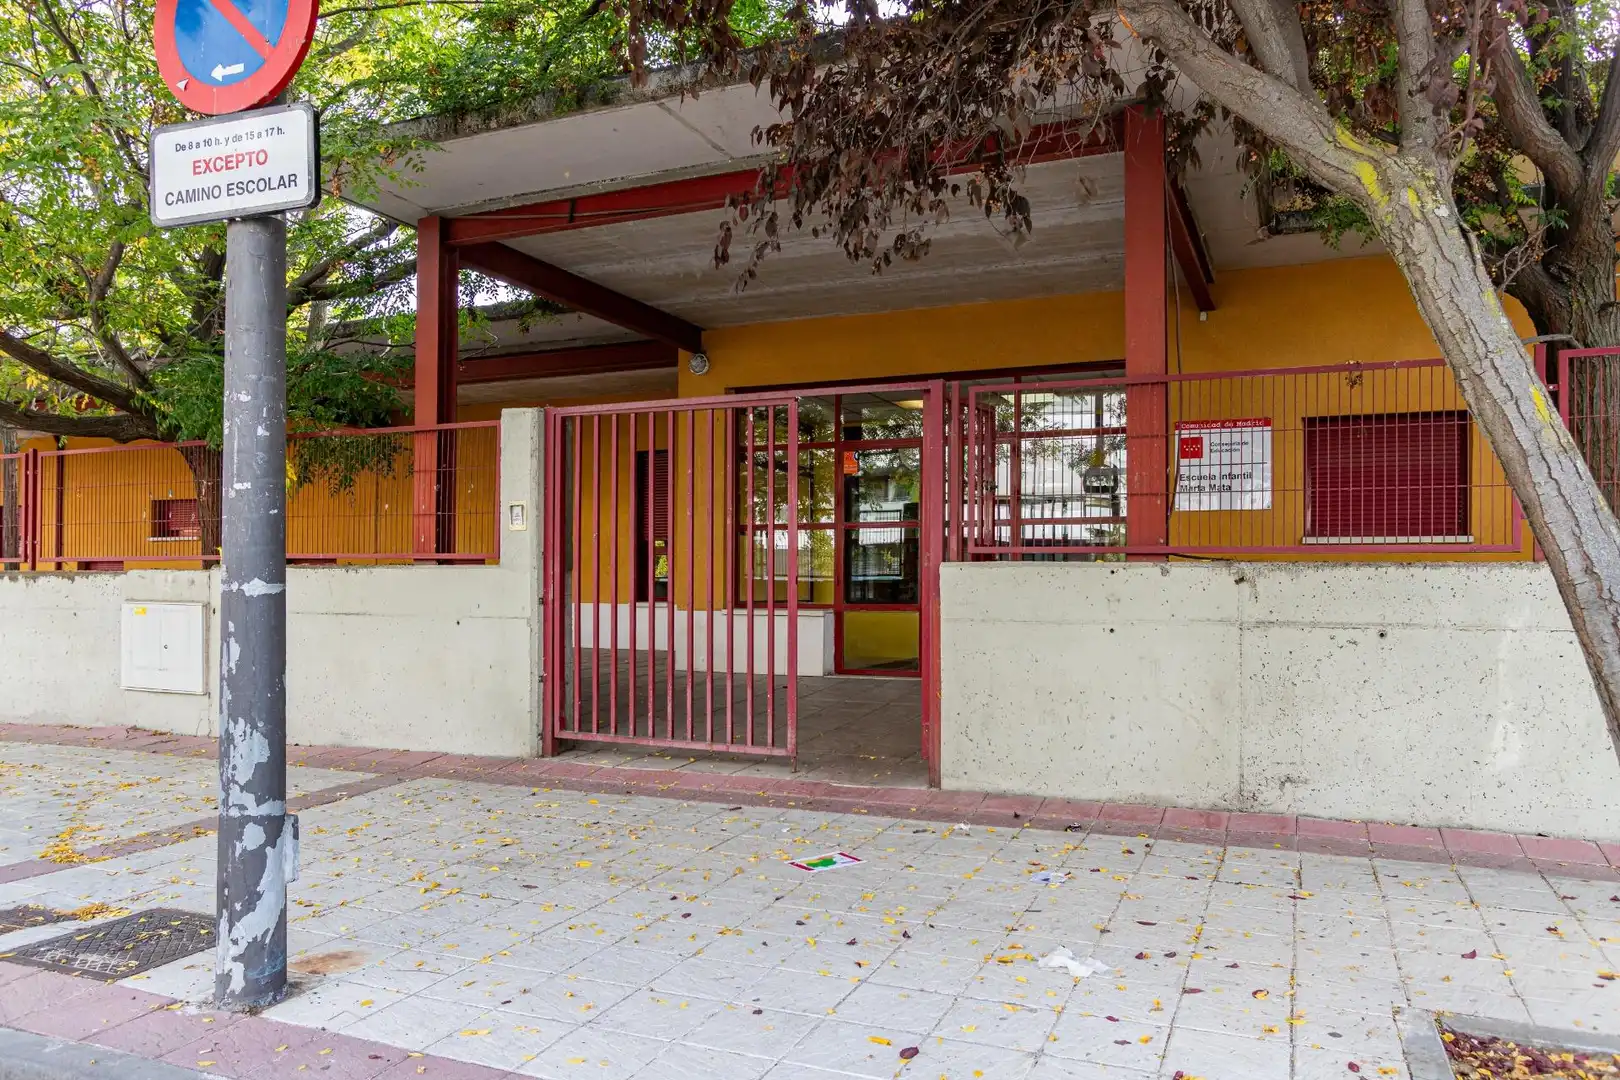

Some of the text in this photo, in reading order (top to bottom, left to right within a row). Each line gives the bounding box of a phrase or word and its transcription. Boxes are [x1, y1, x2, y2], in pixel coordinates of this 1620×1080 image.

[175, 143, 186, 152] De
[188, 141, 194, 150] 8
[195, 141, 200, 149] a
[202, 138, 213, 148] 10
[214, 136, 223, 146] h.
[224, 137, 230, 147] y
[232, 134, 243, 144] de
[245, 131, 255, 141] 15
[265, 127, 275, 137] 17
[276, 126, 285, 136] h.
[192, 149, 268, 177] EXCEPTO
[165, 173, 298, 206] CAMINO ESCOLAR
[1180, 473, 1217, 482] Escuela
